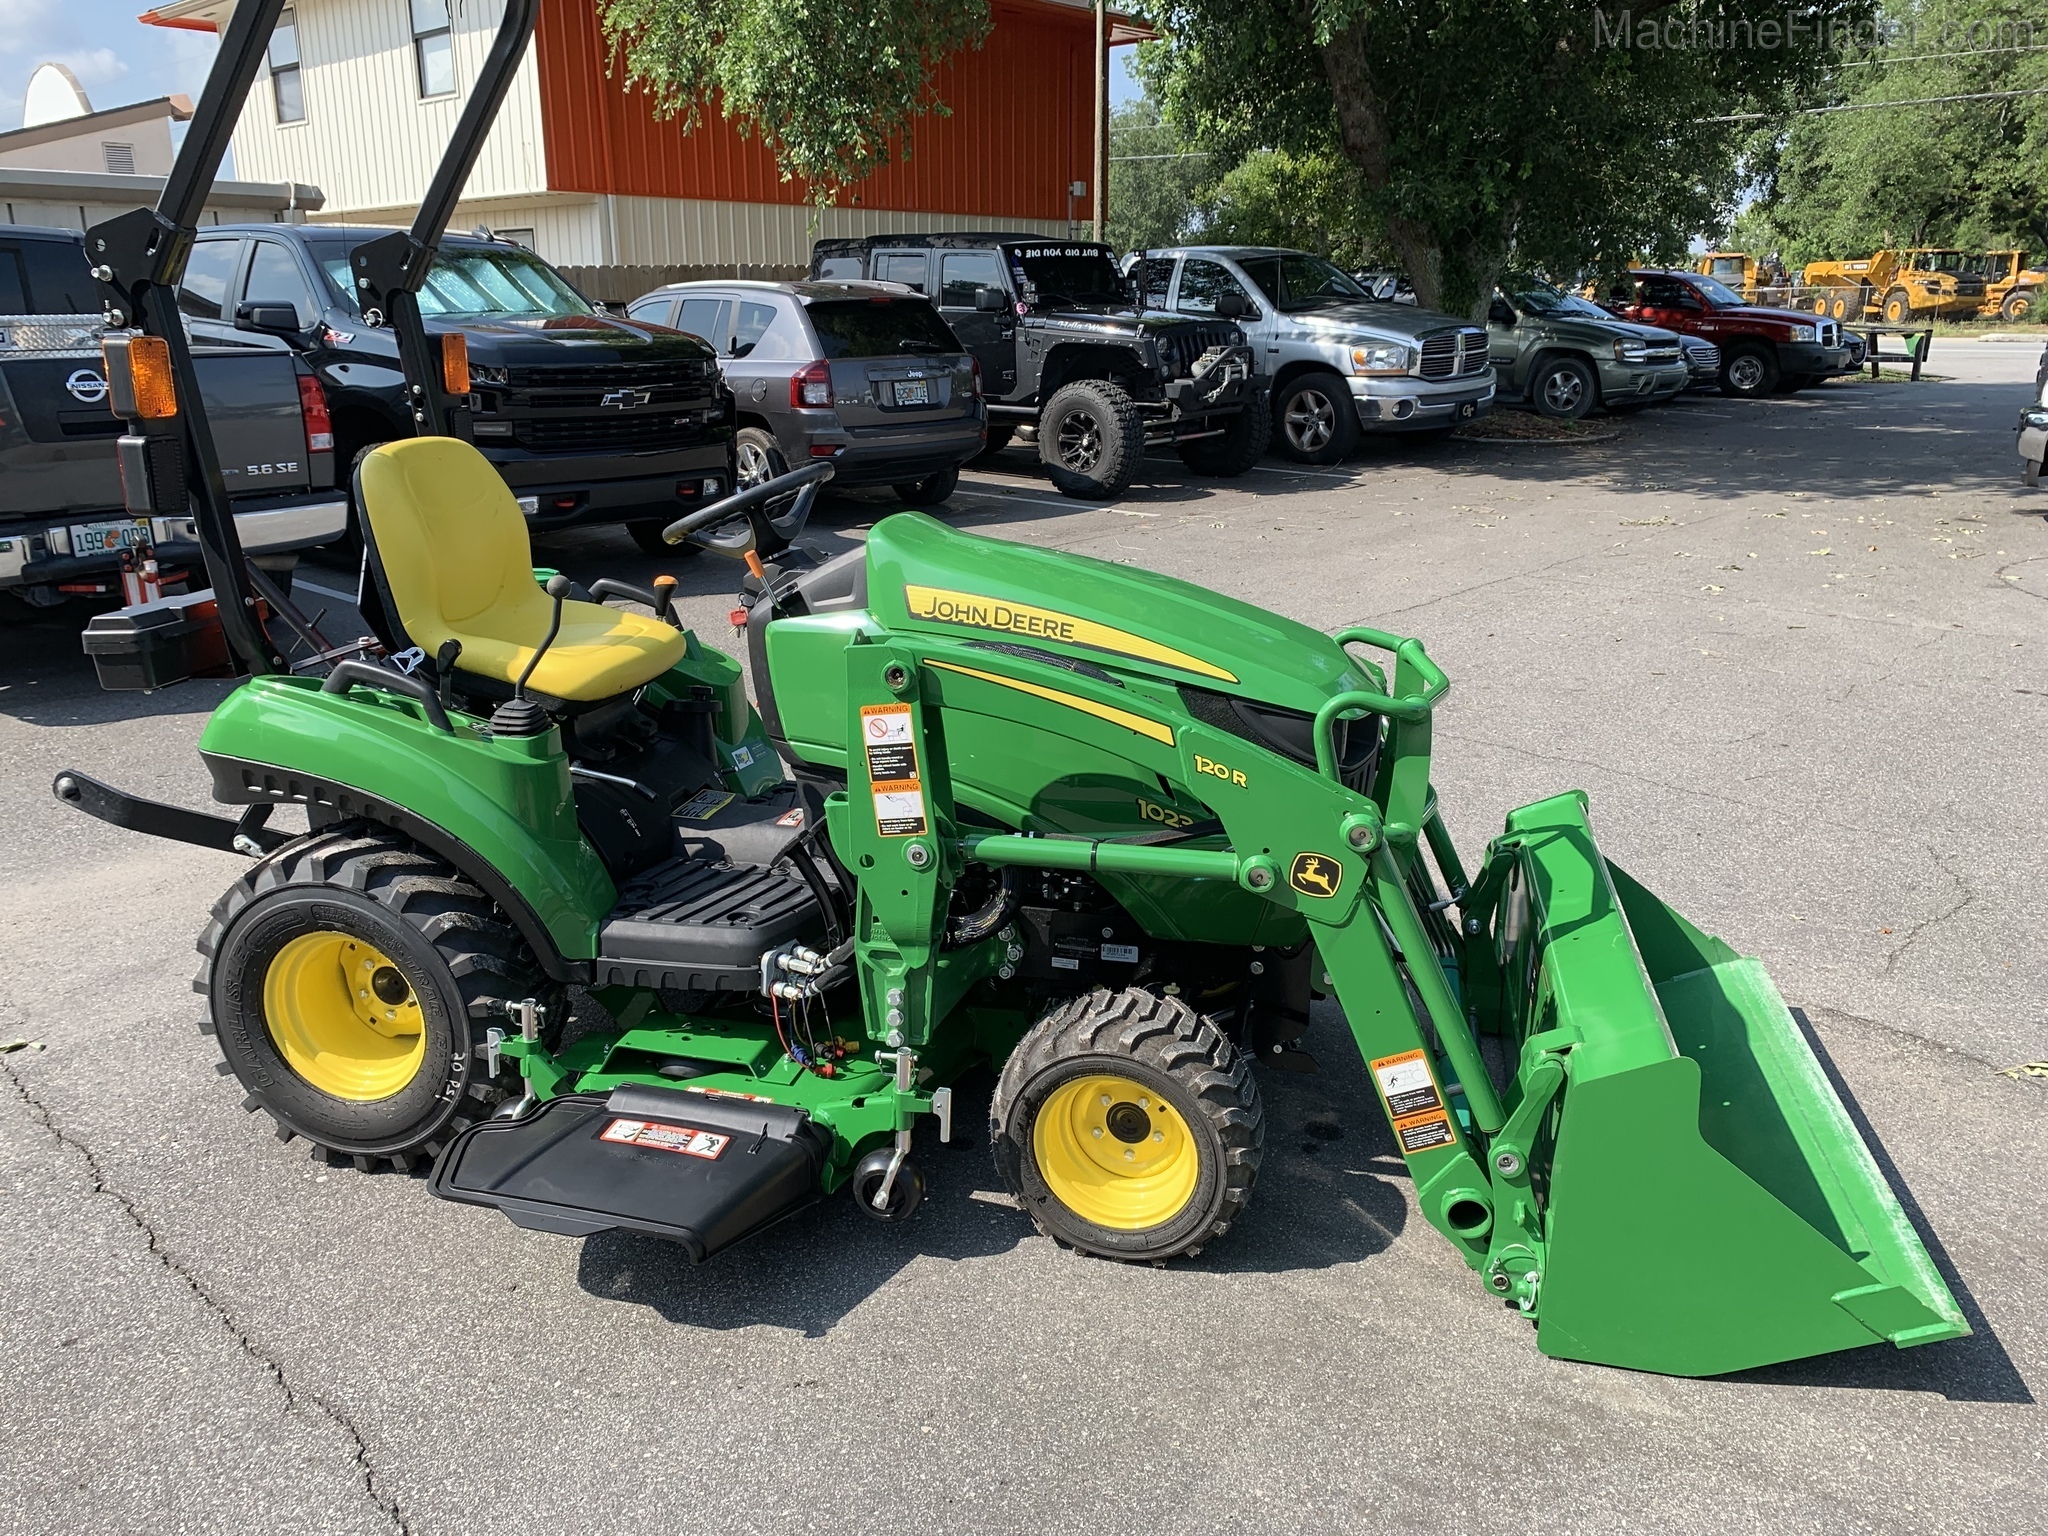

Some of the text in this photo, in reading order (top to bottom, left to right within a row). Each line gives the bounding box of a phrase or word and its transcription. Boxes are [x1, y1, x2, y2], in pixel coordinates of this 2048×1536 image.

[1025, 248, 1099, 258] BUT DID YOU DIE
[907, 370, 923, 379] Jeep
[246, 463, 273, 476] 5.6
[275, 462, 298, 474] SE
[75, 531, 104, 552] 199
[923, 596, 1075, 639] JOHN DEERE
[871, 704, 908, 714] WARNING
[1194, 754, 1248, 789] 120 R
[881, 782, 919, 792] WARNING
[226, 946, 275, 1088] CARLISLE
[451, 1052, 466, 1072] 20
[1386, 1053, 1419, 1065] WARNING
[1409, 1114, 1442, 1126] WARNING
